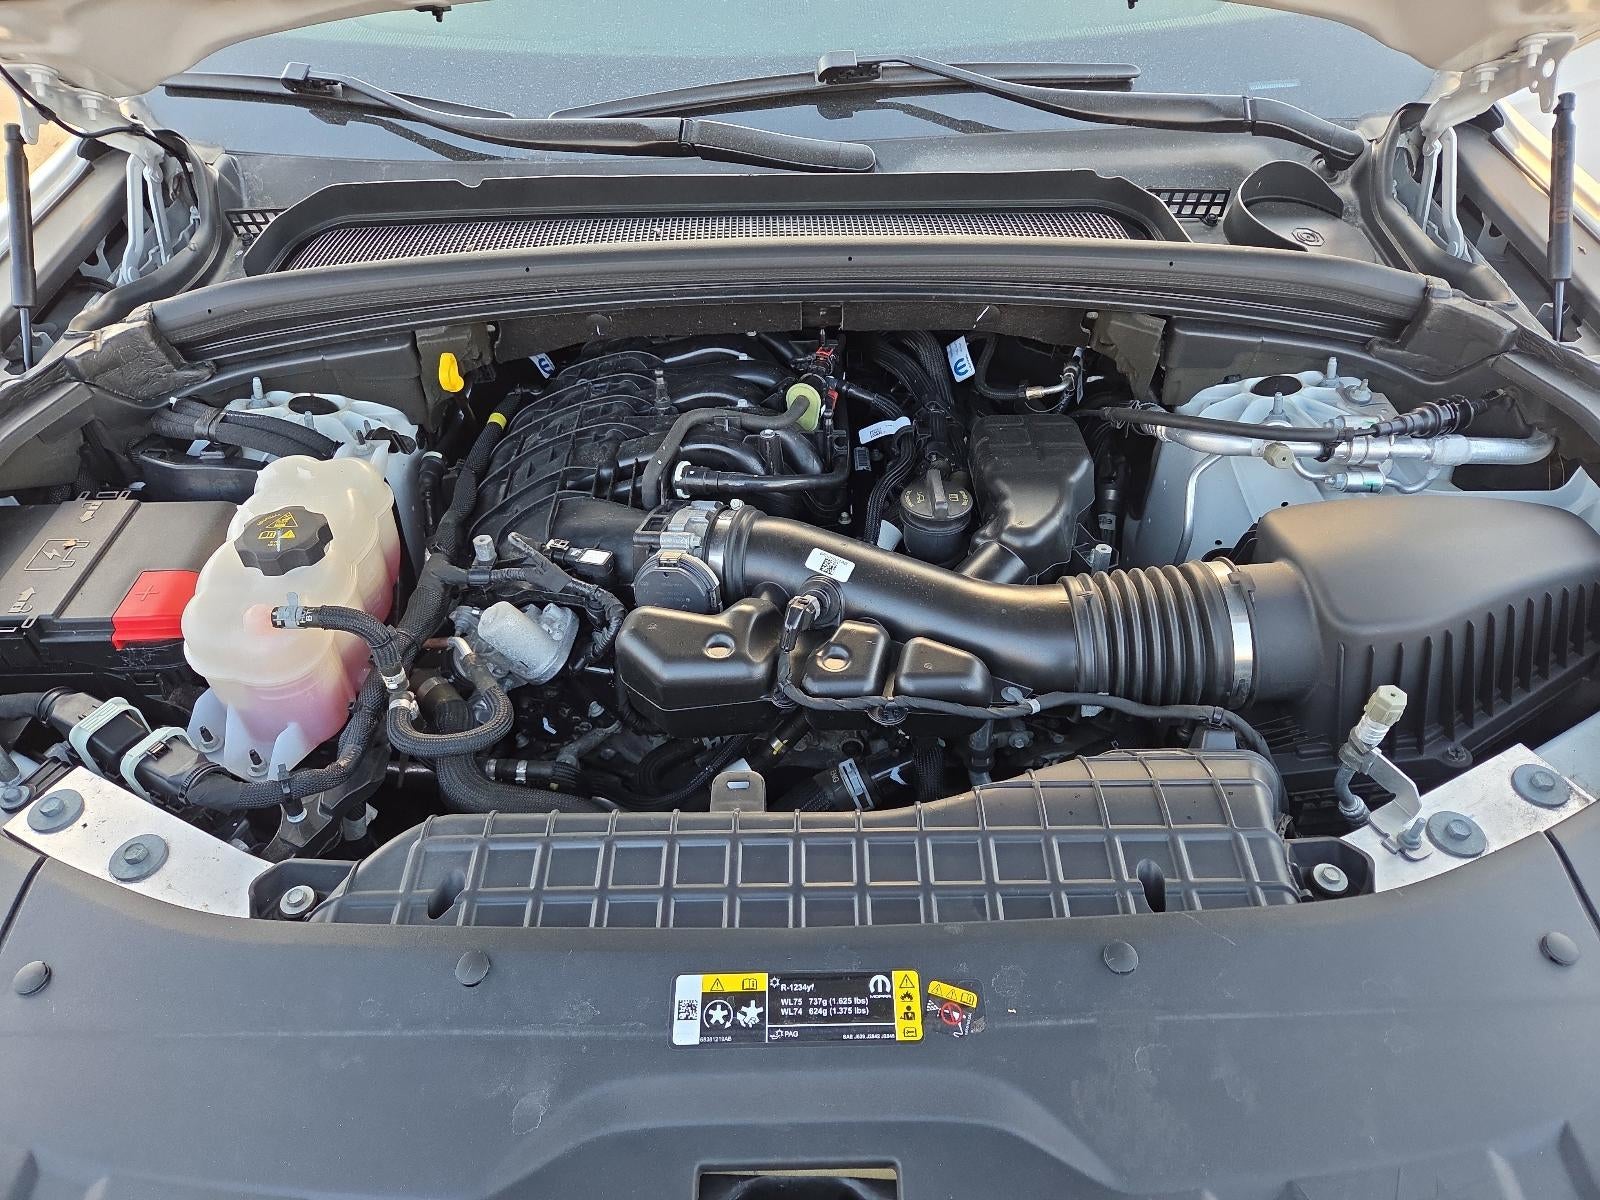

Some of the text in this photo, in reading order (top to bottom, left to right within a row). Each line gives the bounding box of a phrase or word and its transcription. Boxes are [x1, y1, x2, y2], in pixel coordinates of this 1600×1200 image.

[780, 983, 815, 993] R-1234yf
[780, 996, 869, 1007] WL75 737g (1.625 lbs)
[780, 1006, 870, 1017] WL74 624g (1.375 lbs)
[784, 1030, 799, 1038] PAG
